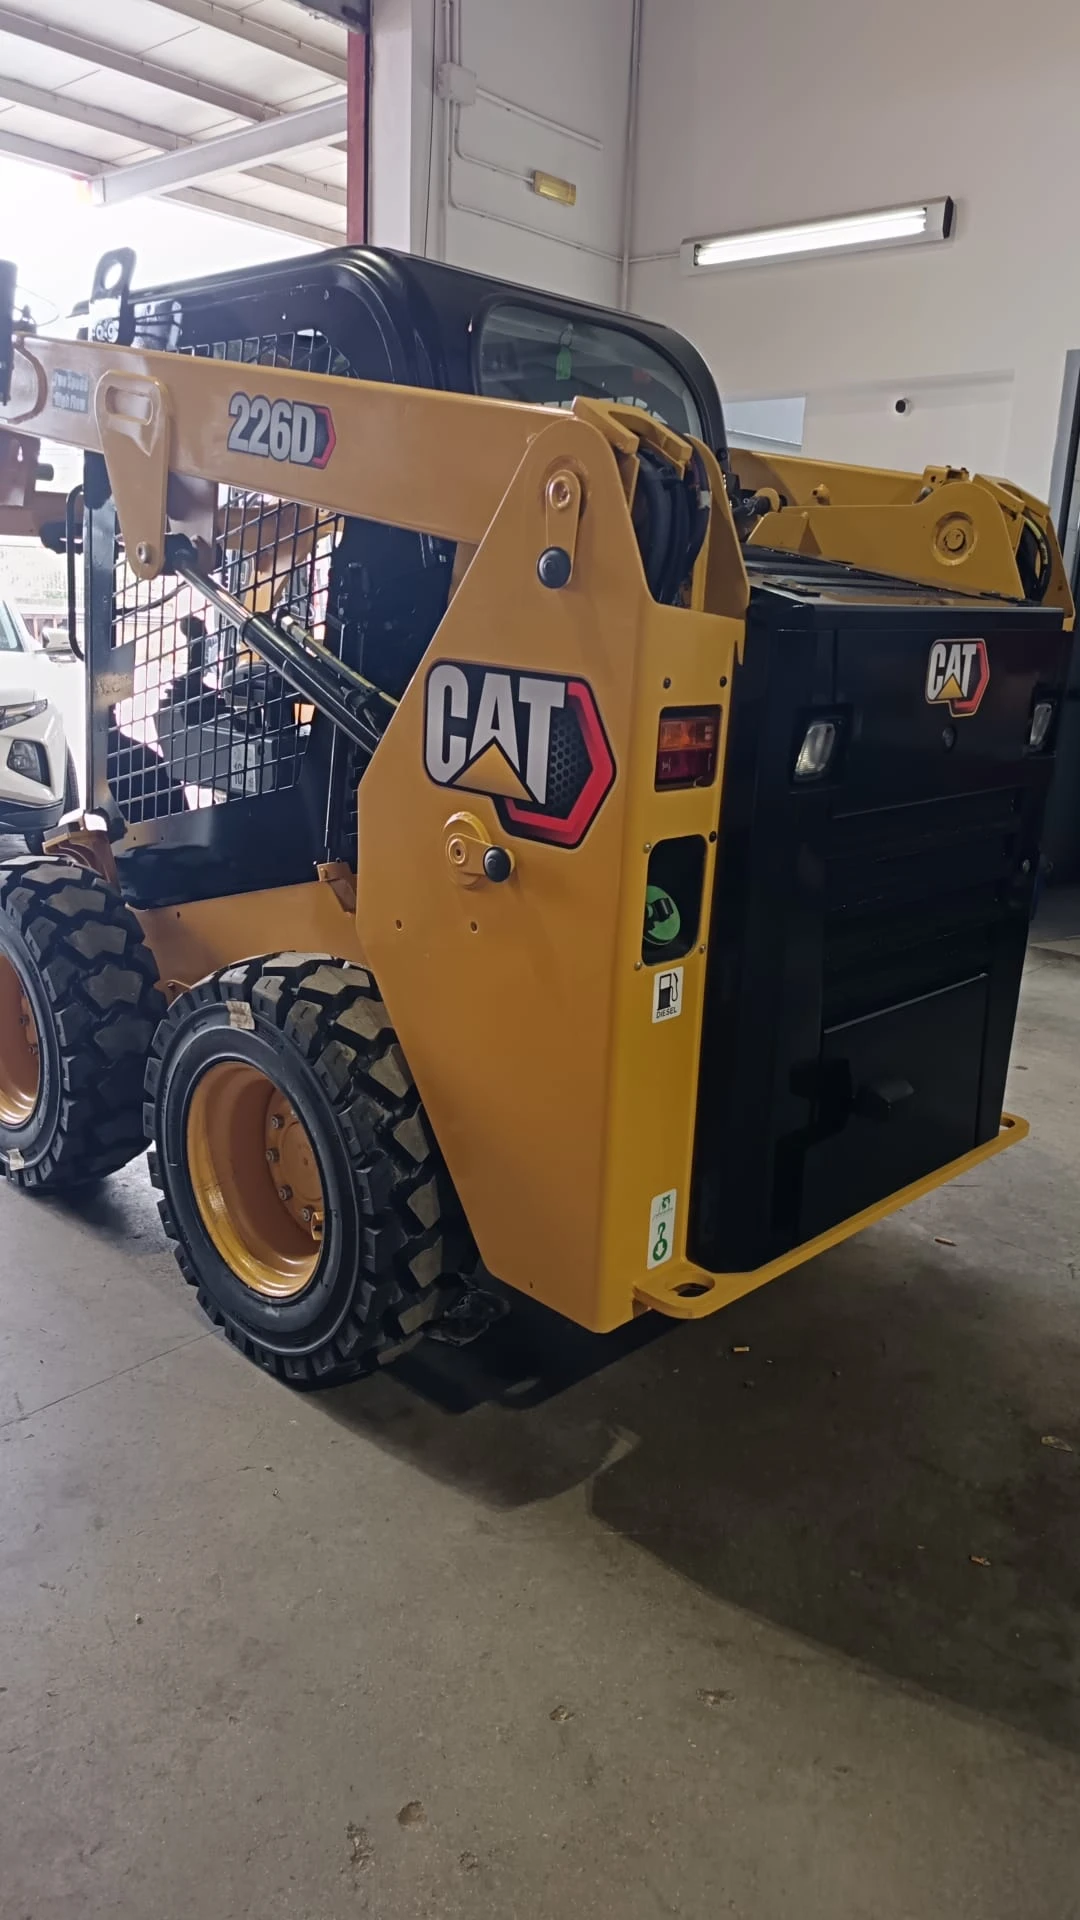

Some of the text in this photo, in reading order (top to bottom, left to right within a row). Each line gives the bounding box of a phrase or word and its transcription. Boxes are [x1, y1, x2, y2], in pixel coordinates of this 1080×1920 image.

[228, 393, 316, 463] 226D
[927, 643, 977, 700] CAT
[426, 664, 566, 805] CAT
[656, 1006, 677, 1019] DIESEL
